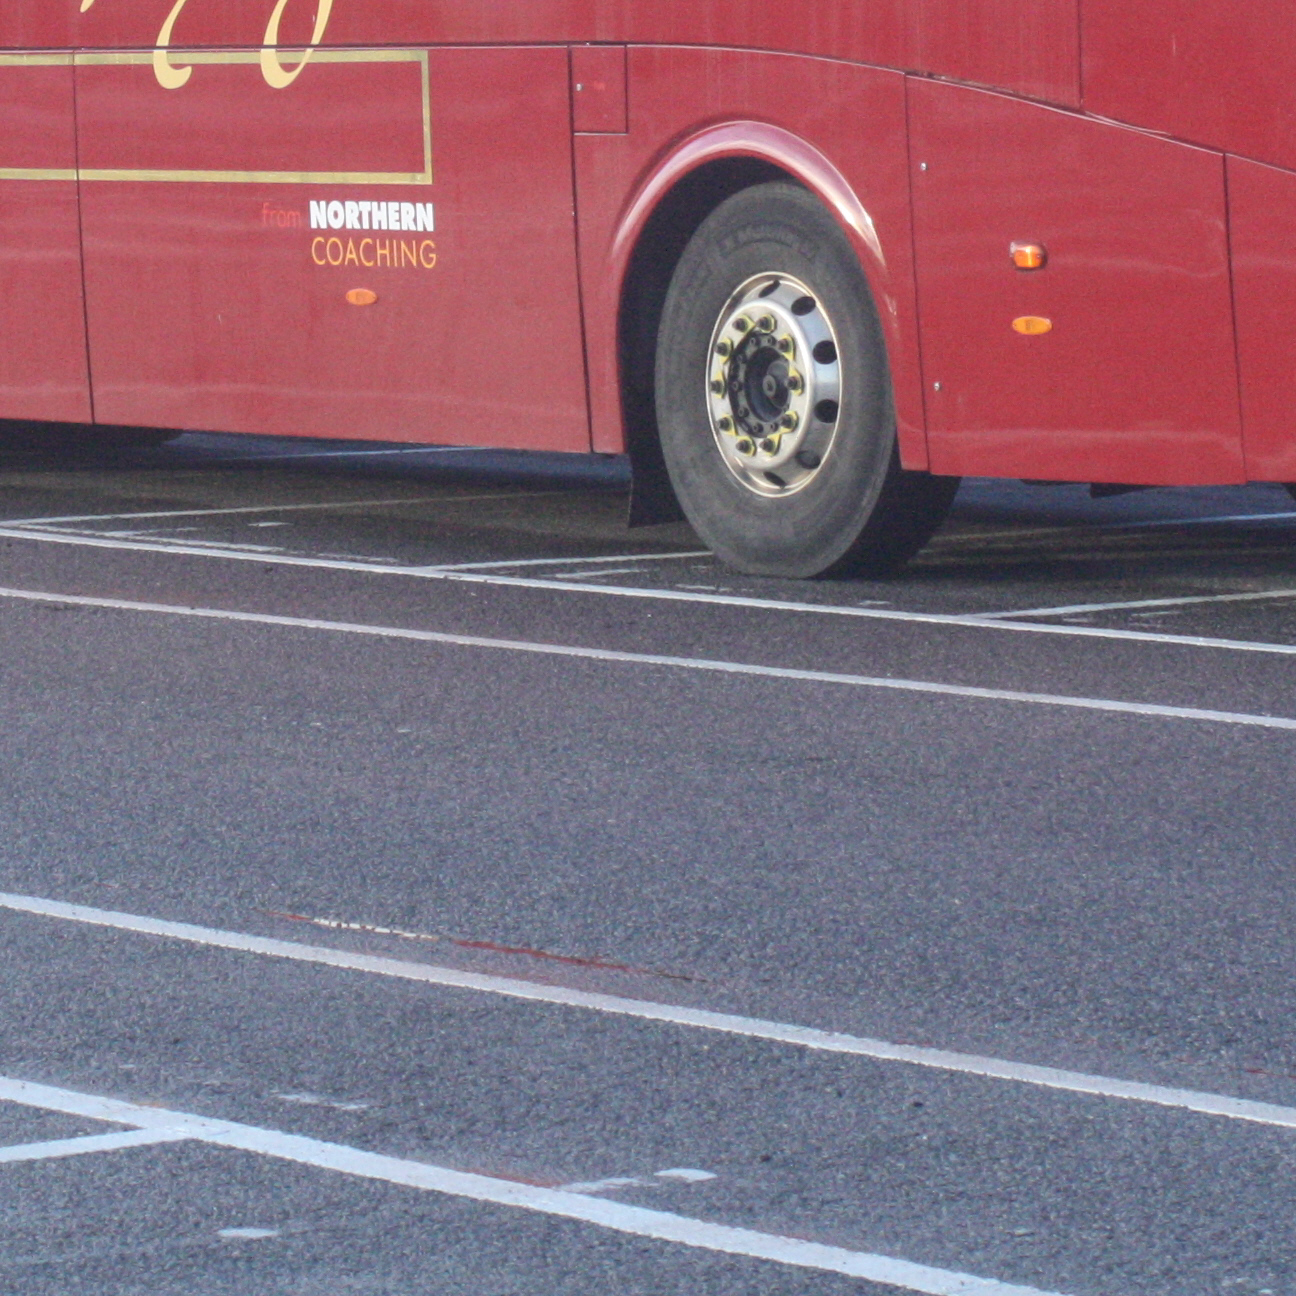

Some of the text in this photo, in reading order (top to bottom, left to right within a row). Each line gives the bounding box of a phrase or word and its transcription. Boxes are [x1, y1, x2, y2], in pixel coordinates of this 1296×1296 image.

[261, 200, 435, 232] from NORTHERN
[311, 236, 437, 269] COACHING
